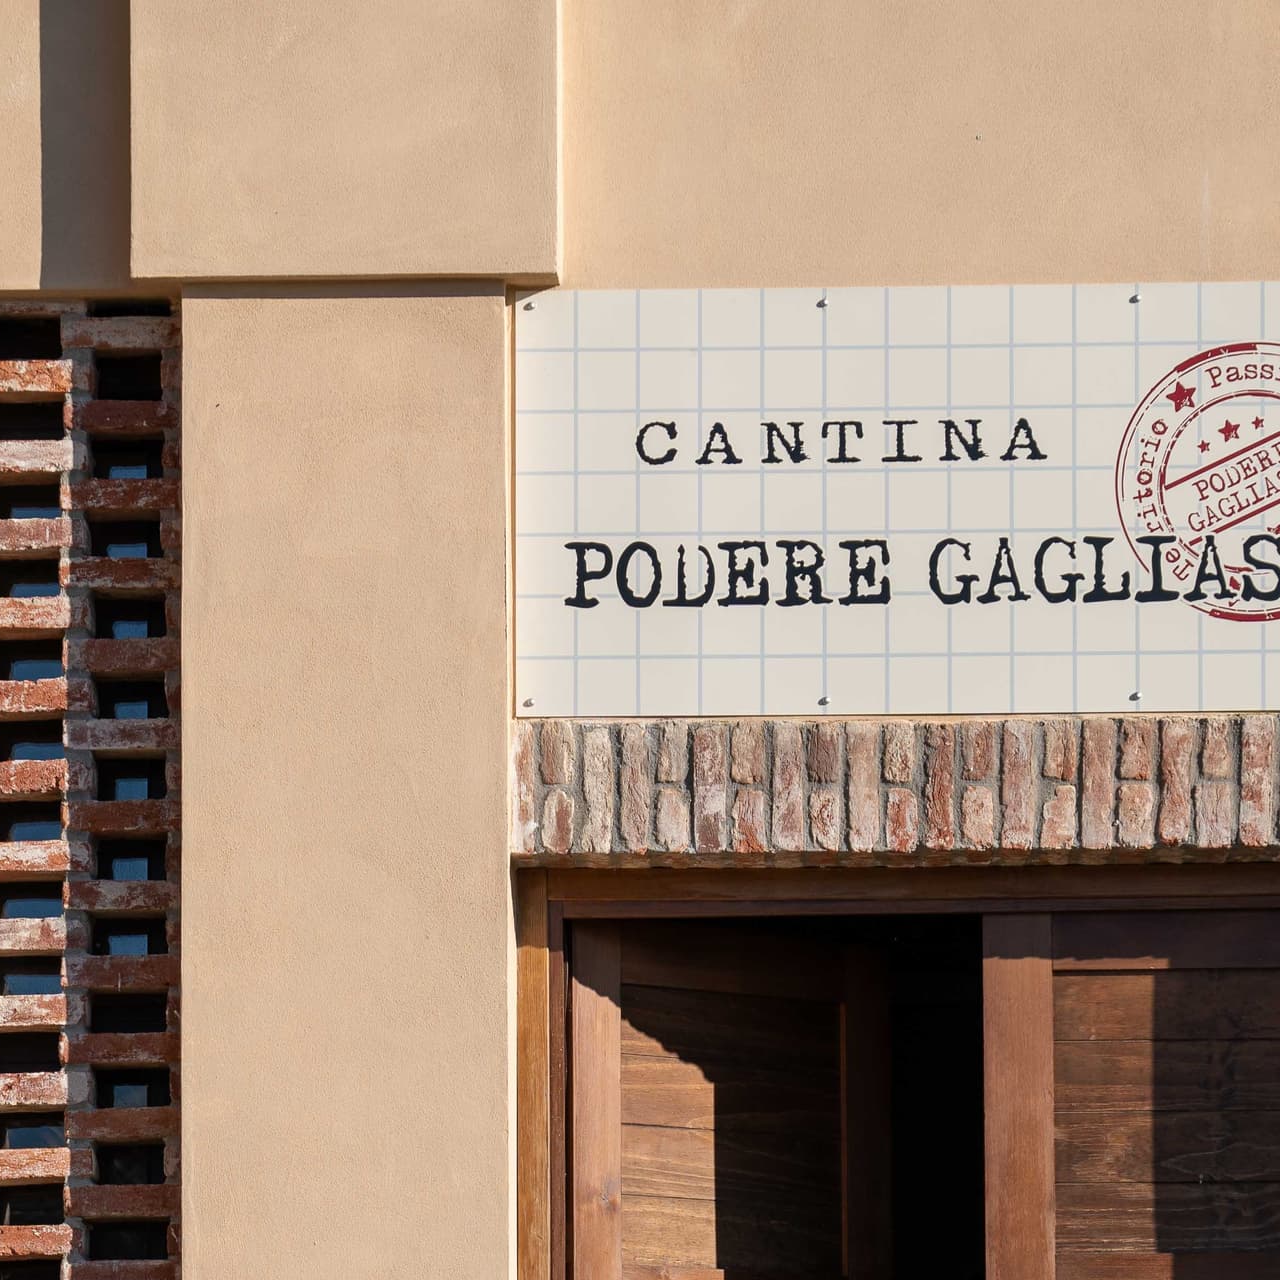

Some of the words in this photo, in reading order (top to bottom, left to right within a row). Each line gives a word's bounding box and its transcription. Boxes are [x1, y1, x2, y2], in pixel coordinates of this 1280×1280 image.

[635, 418, 1048, 466] CANTINA
[1132, 417, 1195, 582] Teritorio
[563, 537, 892, 609] PODERE
